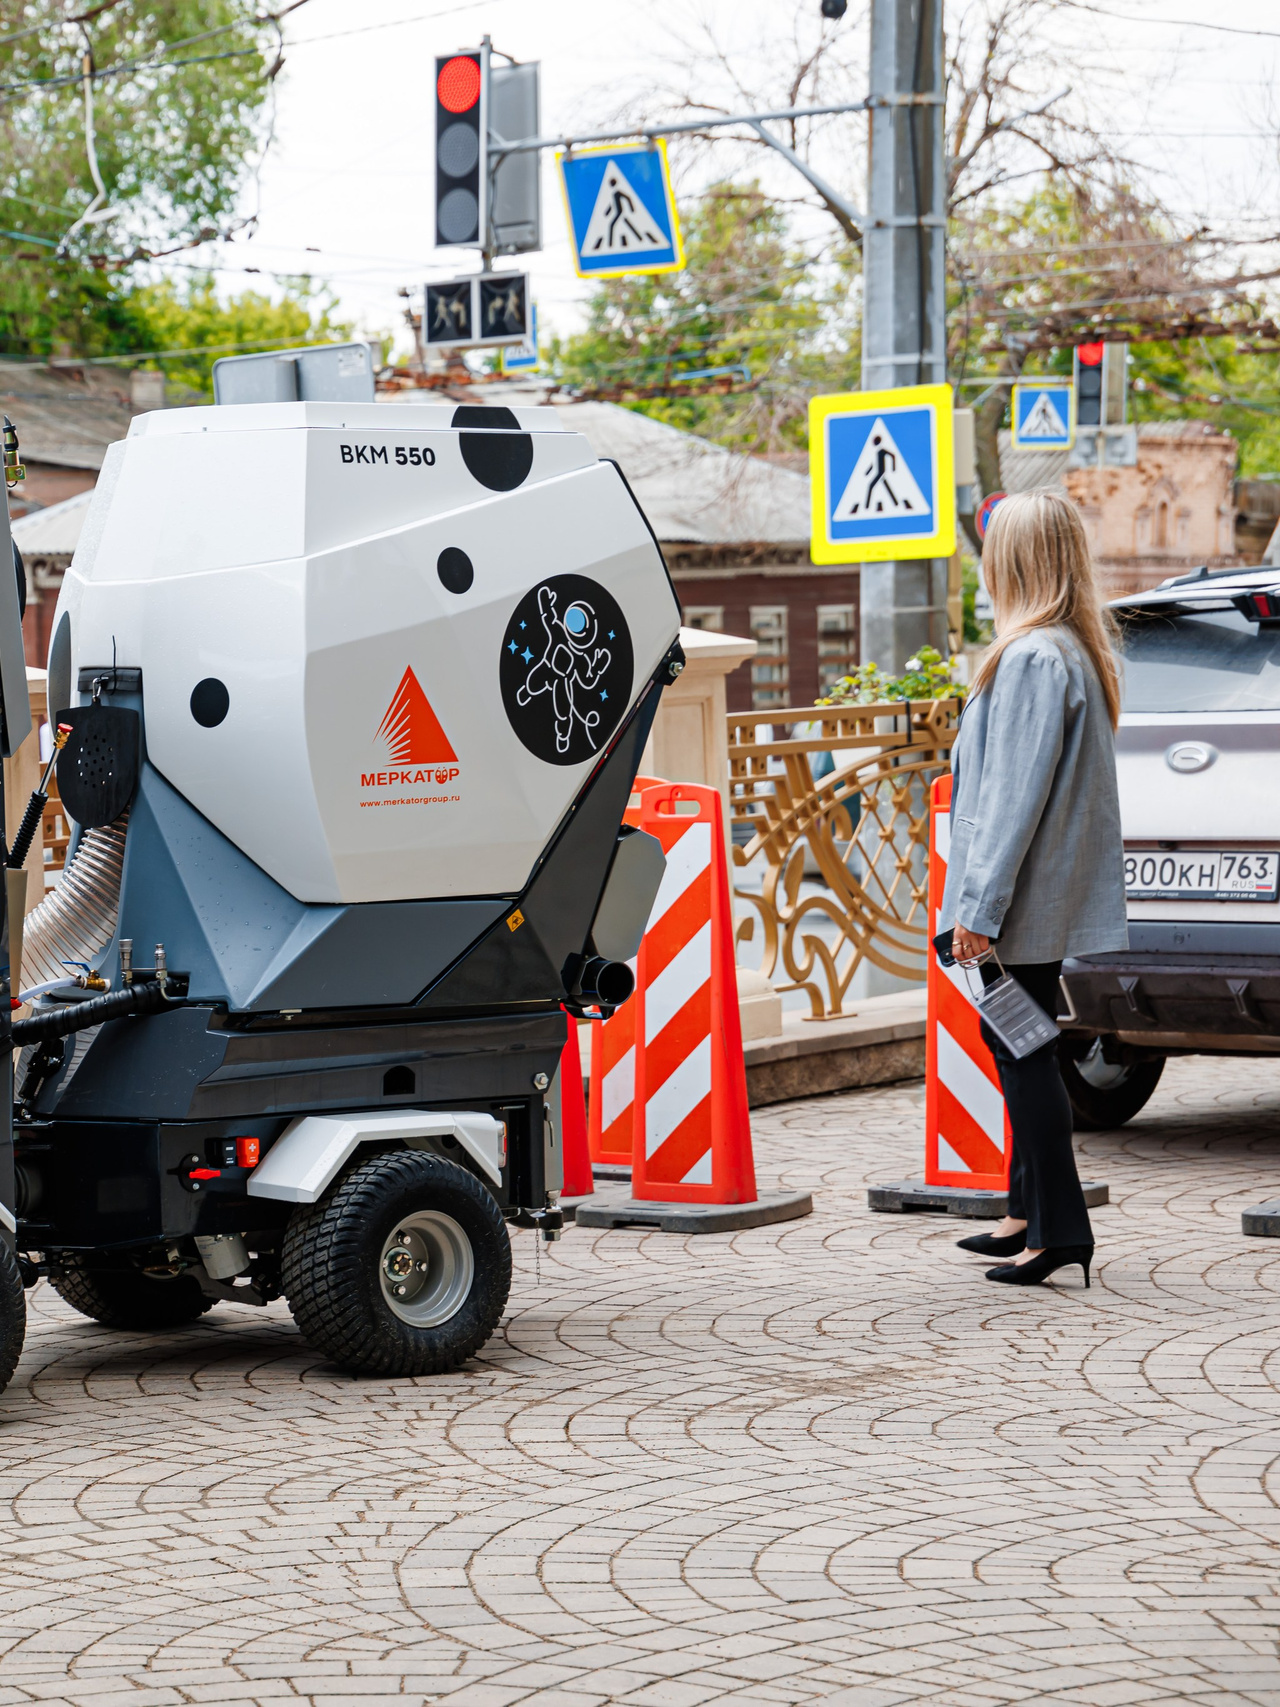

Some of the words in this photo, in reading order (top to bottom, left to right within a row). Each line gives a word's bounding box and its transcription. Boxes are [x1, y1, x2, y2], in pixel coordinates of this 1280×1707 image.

[339, 444, 389, 465] ВКМ
[394, 446, 436, 467] 550
[360, 766, 460, 787] МЕРКАТОР
[360, 795, 461, 808] www.merkatorgroup.ru
[1223, 856, 1270, 880] 763
[1231, 880, 1255, 890] RUS
